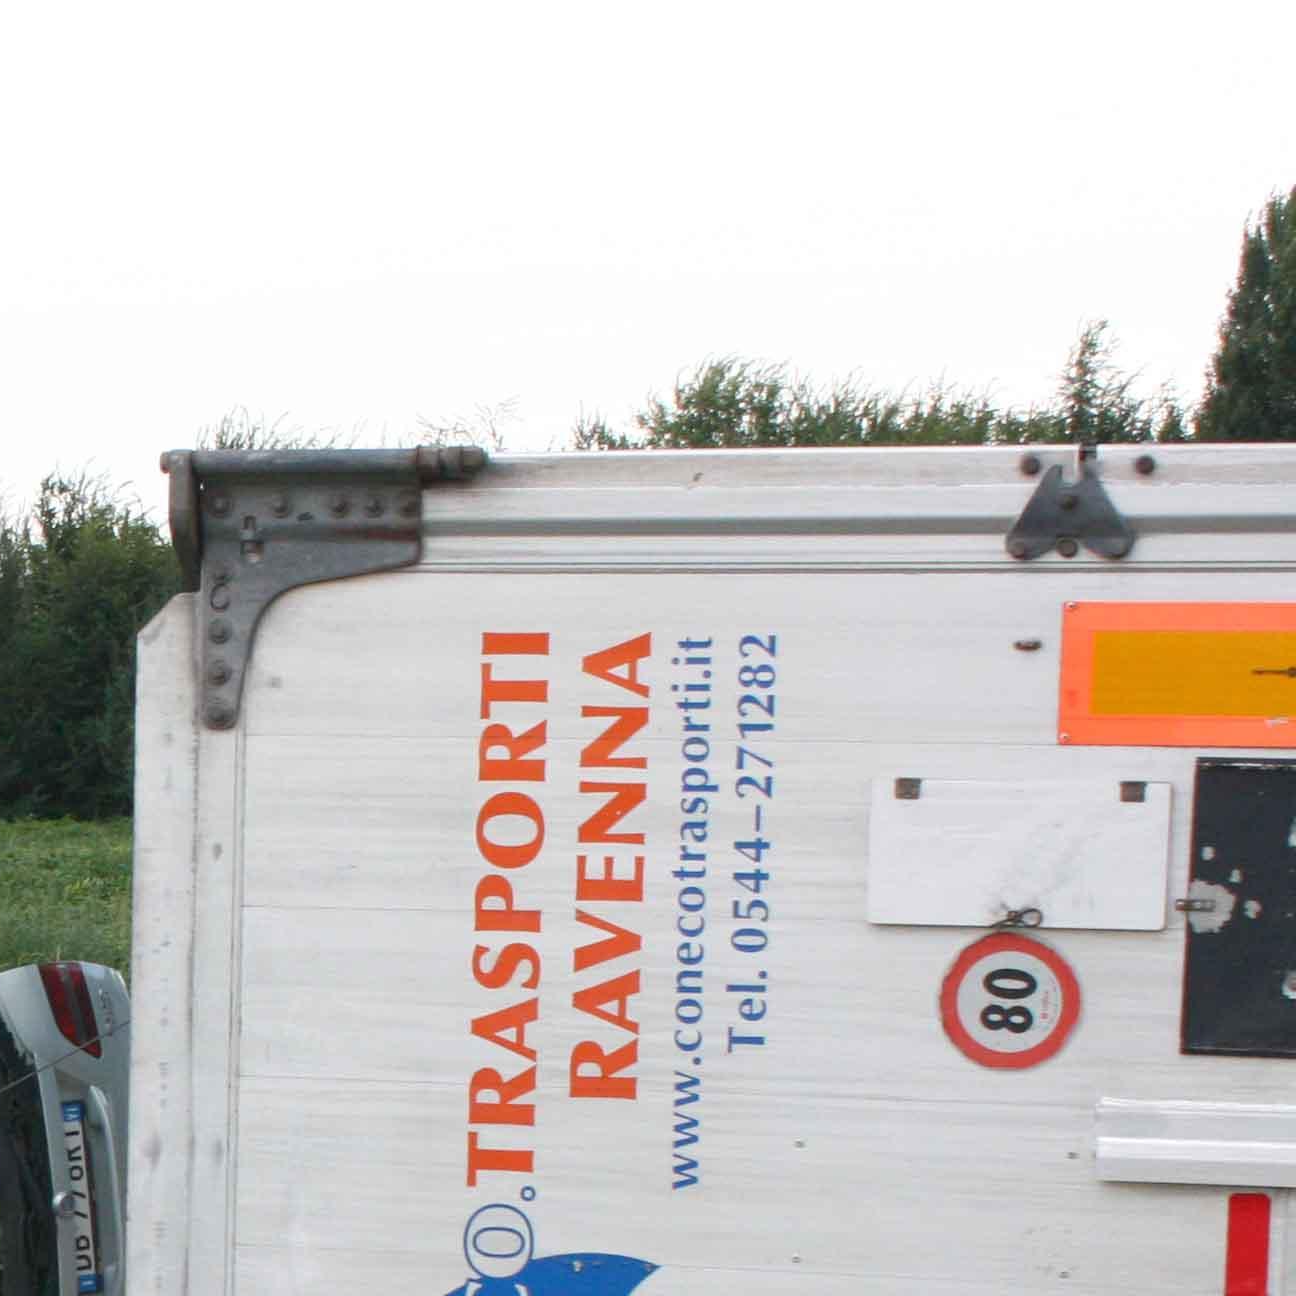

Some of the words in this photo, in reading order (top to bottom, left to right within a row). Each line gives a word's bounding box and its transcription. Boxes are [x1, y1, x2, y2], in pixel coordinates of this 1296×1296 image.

[467, 632, 550, 1186] TRASPORTI
[569, 631, 652, 1100] RAVENNA
[671, 635, 720, 1191] www.conecotrasporti.it
[729, 633, 778, 954] 0544-271282
[726, 970, 768, 1052] Tel.
[980, 968, 1037, 1034] 80
